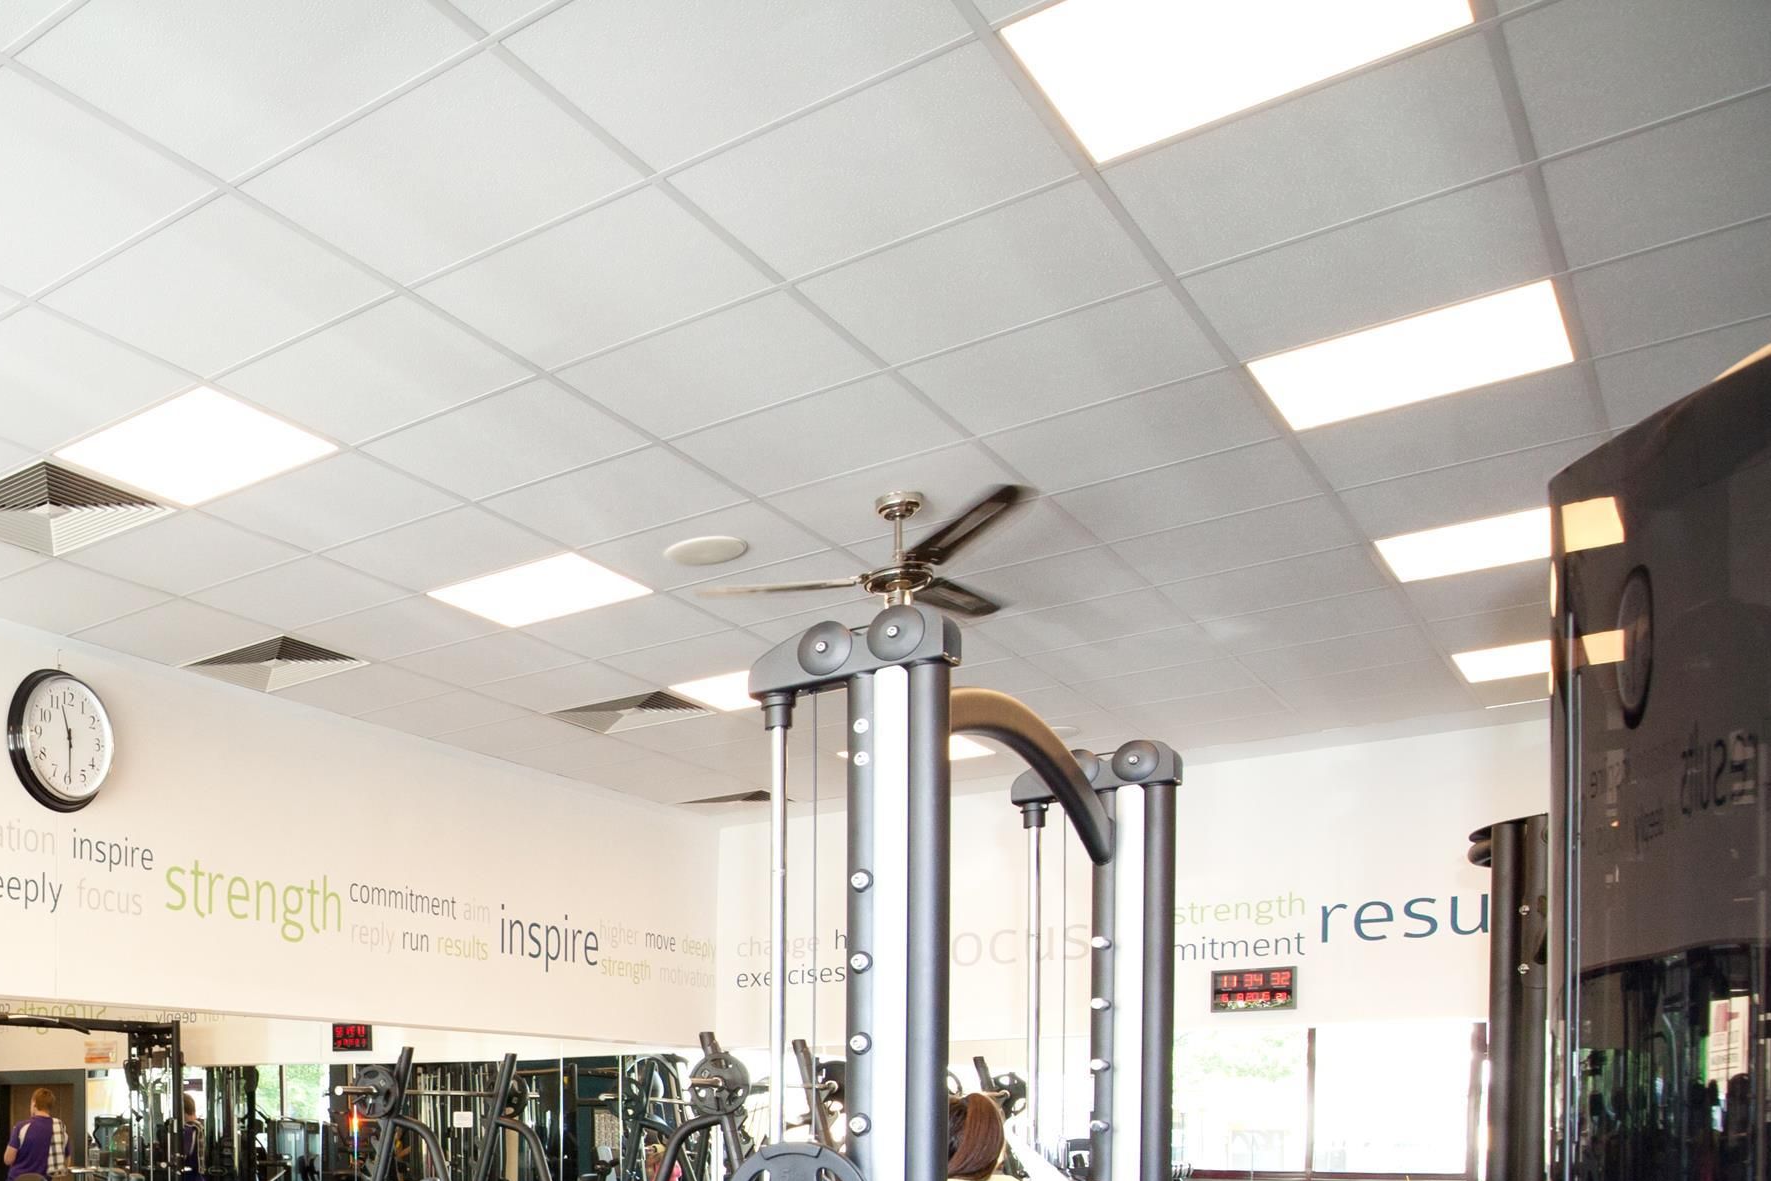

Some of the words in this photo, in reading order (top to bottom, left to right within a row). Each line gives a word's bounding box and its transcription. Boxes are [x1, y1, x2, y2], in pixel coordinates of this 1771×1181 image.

[50, 694, 59, 710] 11
[63, 691, 75, 707] 12
[40, 708, 52, 724] 10
[89, 715, 96, 730] 2
[34, 725, 43, 738] 9
[94, 738, 101, 752] 3
[39, 747, 47, 761] 8
[51, 763, 58, 777] 7
[88, 757, 96, 769] 4
[64, 771, 72, 785] 6
[79, 769, 87, 783] 5
[72, 828, 154, 873] inspire
[77, 877, 143, 916] focus
[165, 859, 343, 942] strength
[349, 883, 457, 920] commitment
[463, 897, 491, 924] aim
[1174, 891, 1305, 926] strength
[351, 921, 396, 954] reply
[402, 930, 429, 953] run
[437, 935, 489, 961] results
[500, 903, 599, 973] inspire
[599, 919, 639, 949] higher
[644, 931, 676, 952] move
[681, 934, 717, 962] deeply
[601, 955, 652, 985] strength
[659, 963, 717, 989] motivation
[736, 963, 846, 988] execises
